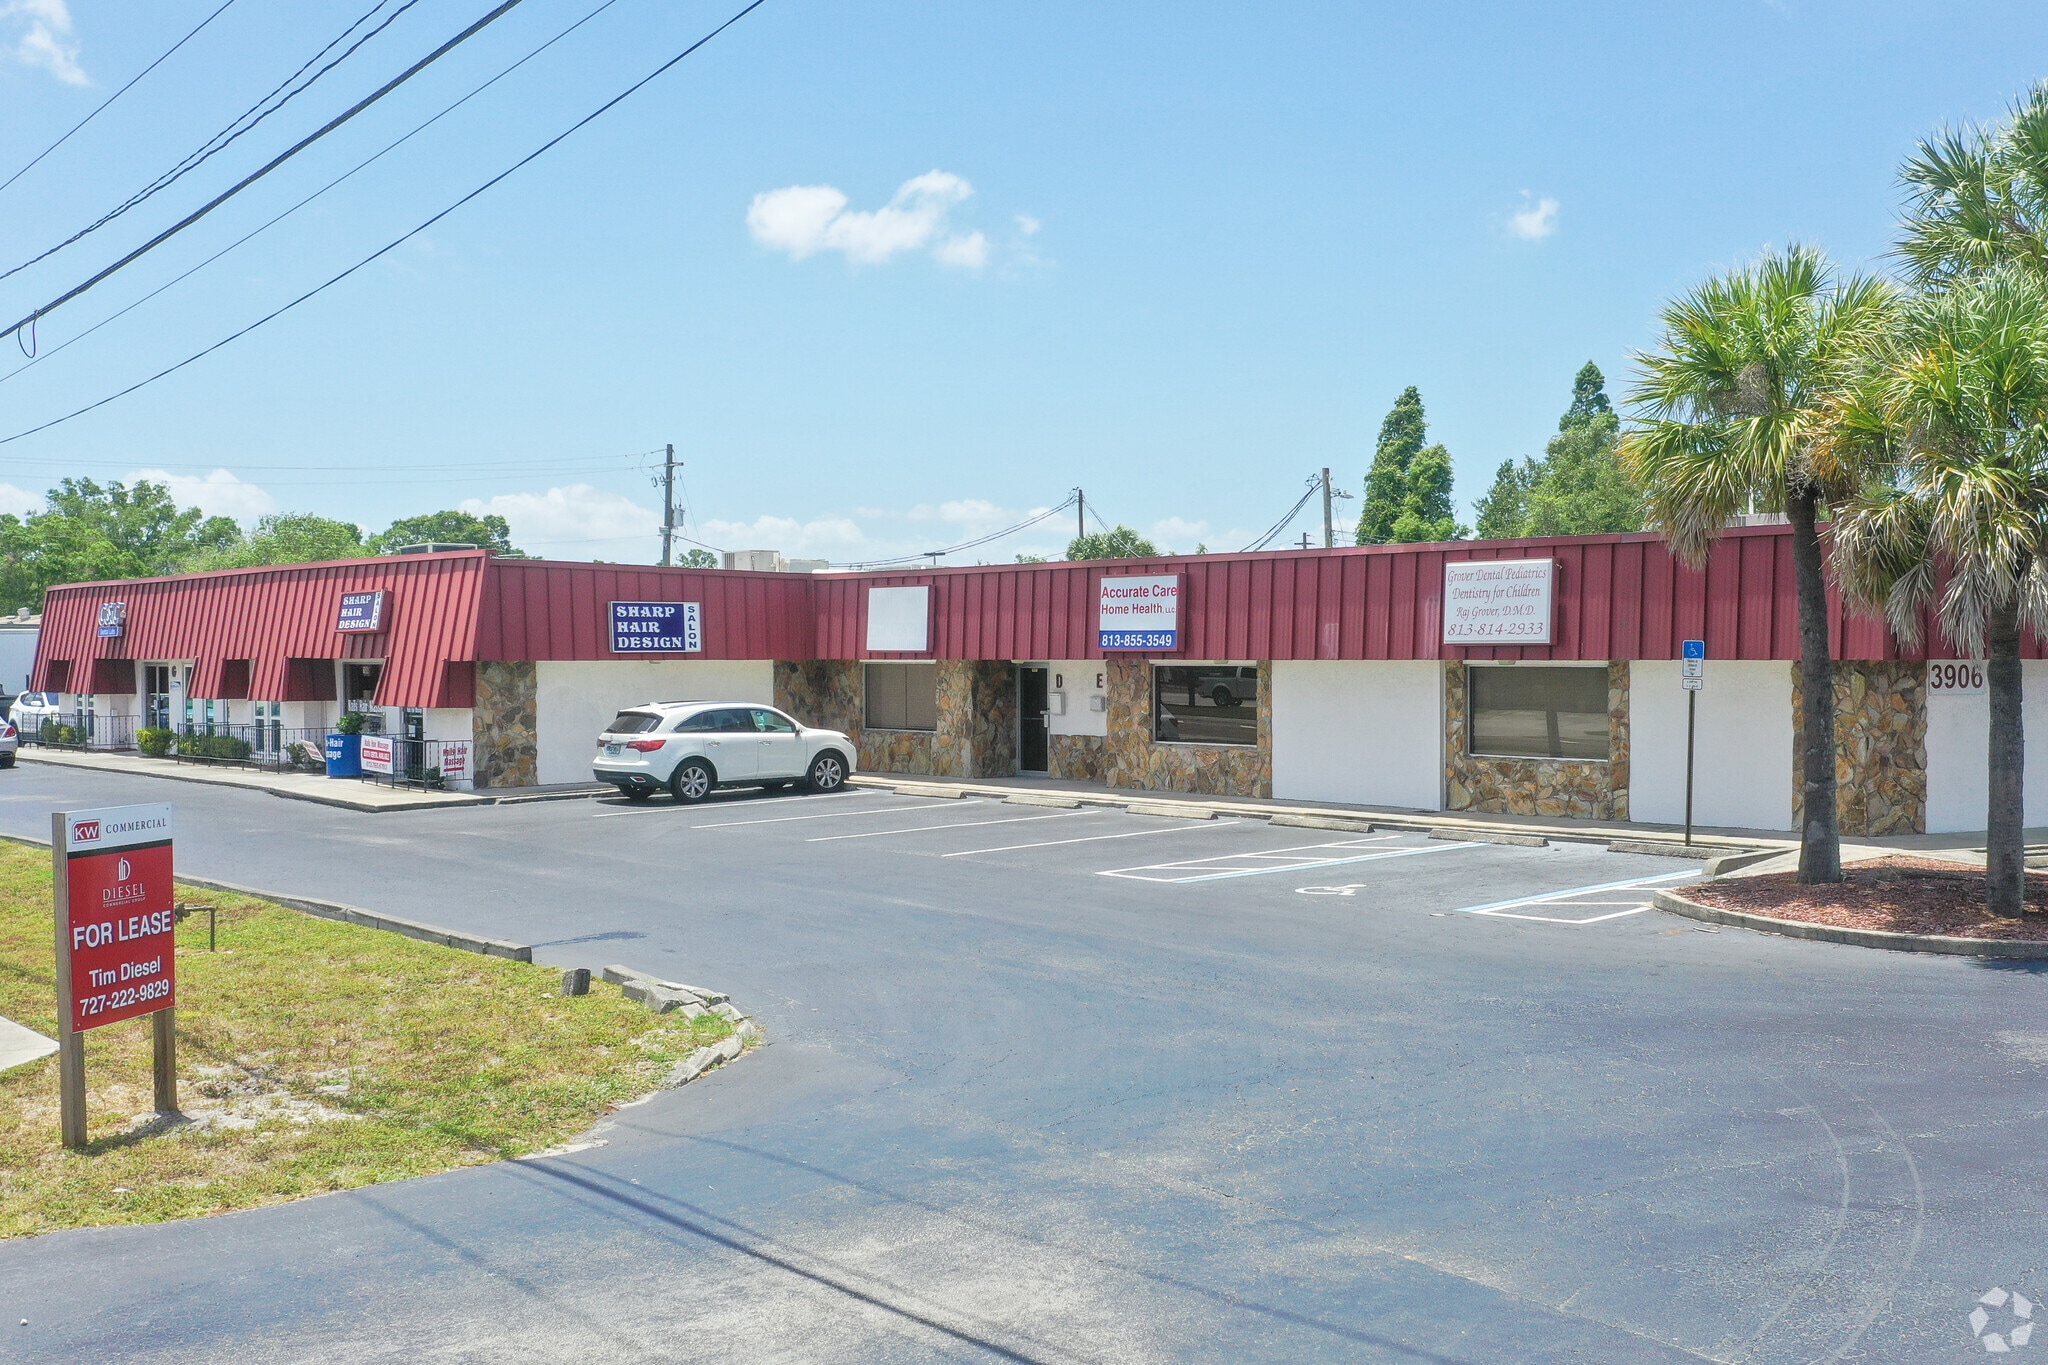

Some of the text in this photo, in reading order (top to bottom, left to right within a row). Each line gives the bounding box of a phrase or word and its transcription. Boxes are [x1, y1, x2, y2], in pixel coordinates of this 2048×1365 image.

[1448, 565, 1547, 586] Grover Dental Pediatrics
[1101, 584, 1178, 598] Accurate Care
[1453, 583, 1541, 603] Dentistry for Children
[343, 595, 371, 605] SHARP
[341, 608, 362, 617] HAIR
[372, 593, 381, 628] SALON
[616, 606, 675, 617] SHARP
[1101, 604, 1129, 614] Home
[1456, 604, 1536, 620] Raj Grover, D.M.D.
[338, 619, 371, 629] DESIGN
[616, 621, 660, 632] HAIR
[688, 606, 697, 648] SALON
[1448, 623, 1543, 635] 813-814-2933
[617, 637, 683, 648] DESIGN
[1101, 634, 1172, 646] 813-855-3549
[171, 665, 177, 678] G
[1930, 664, 1983, 689] 3906
[1056, 673, 1063, 688] D
[1096, 673, 1103, 688] E
[75, 818, 167, 840] KW COMMERCIAL
[102, 883, 146, 901] DIESEL
[73, 910, 172, 950] FOR LEASE
[89, 955, 160, 988] Tim Diesel
[80, 979, 169, 1017] 727-222-9829
